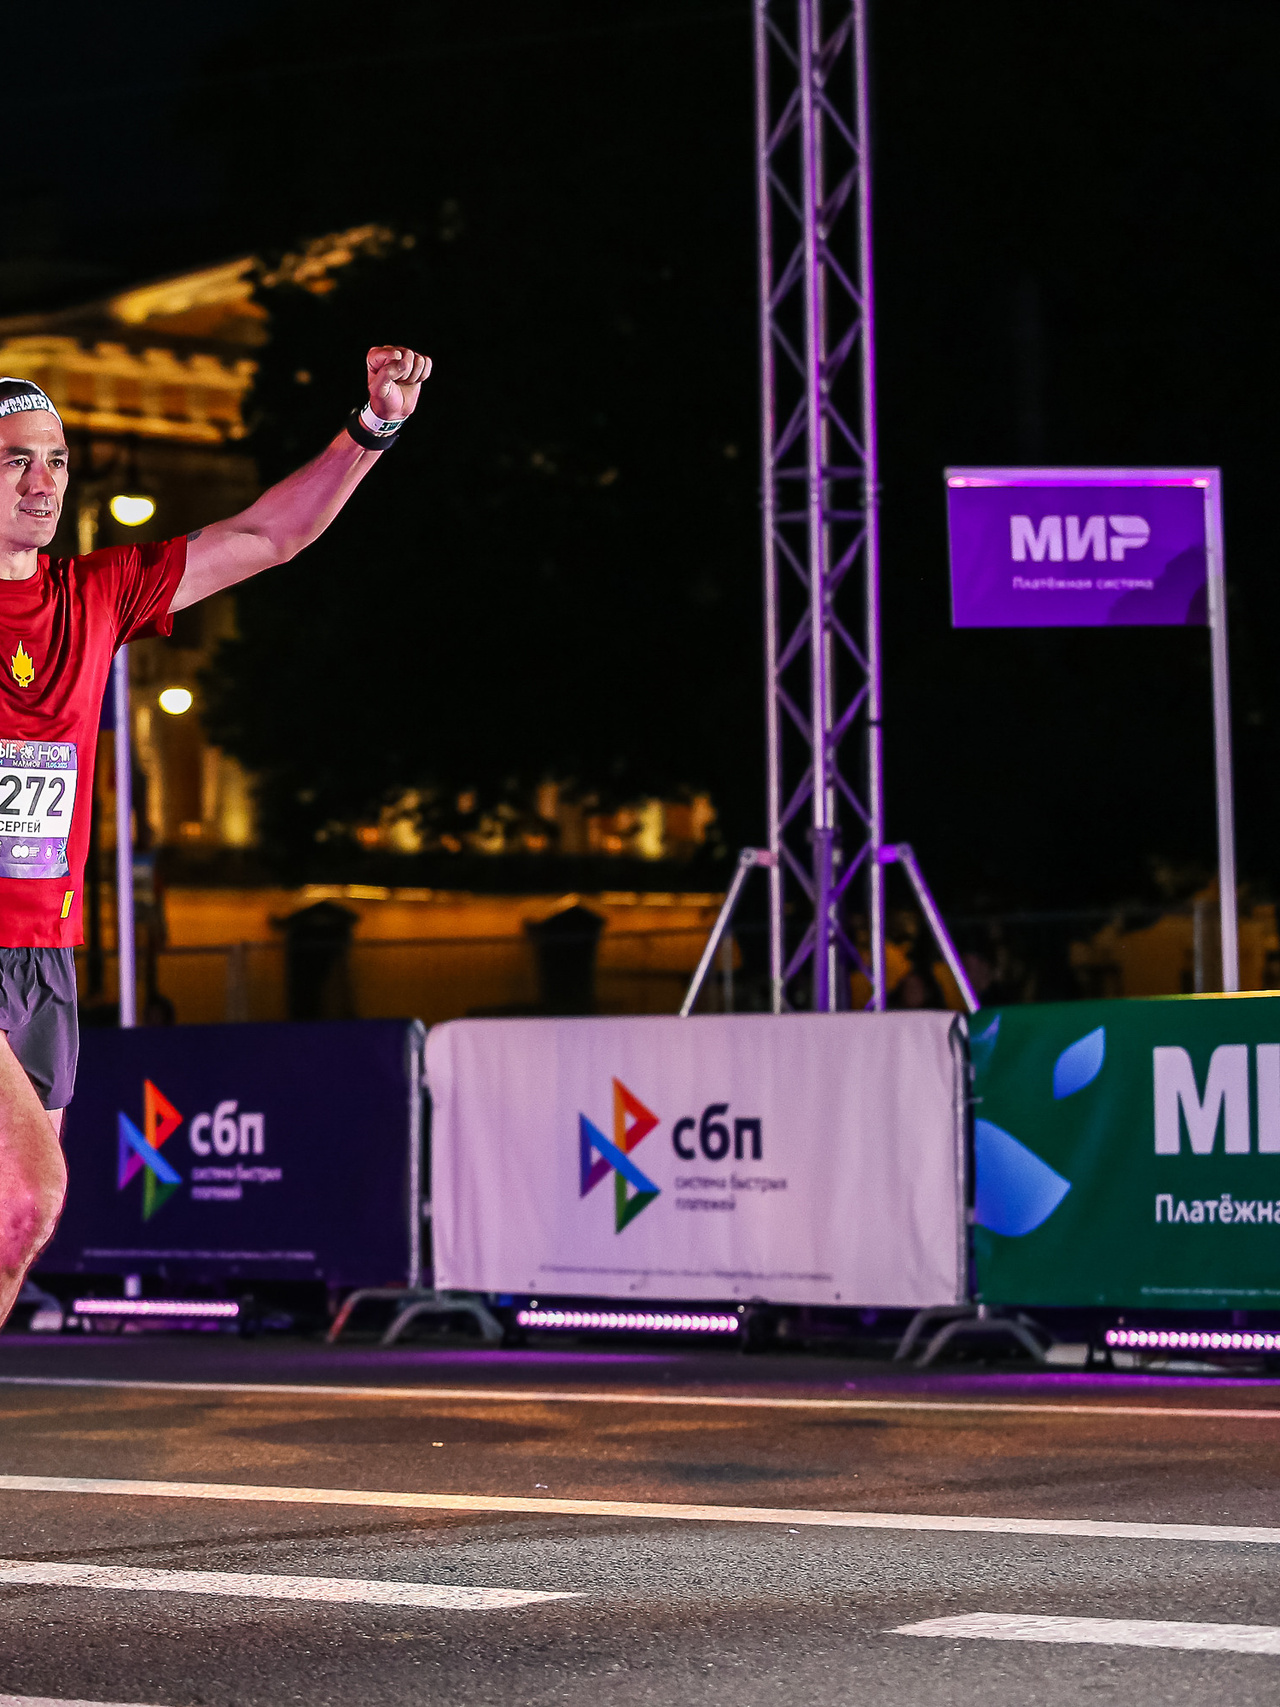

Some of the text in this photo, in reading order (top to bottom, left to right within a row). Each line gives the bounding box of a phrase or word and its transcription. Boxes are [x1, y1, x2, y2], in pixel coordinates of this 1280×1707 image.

[1010, 514, 1151, 562] МИР
[188, 1099, 265, 1157] сбп
[672, 1102, 763, 1161] сбп
